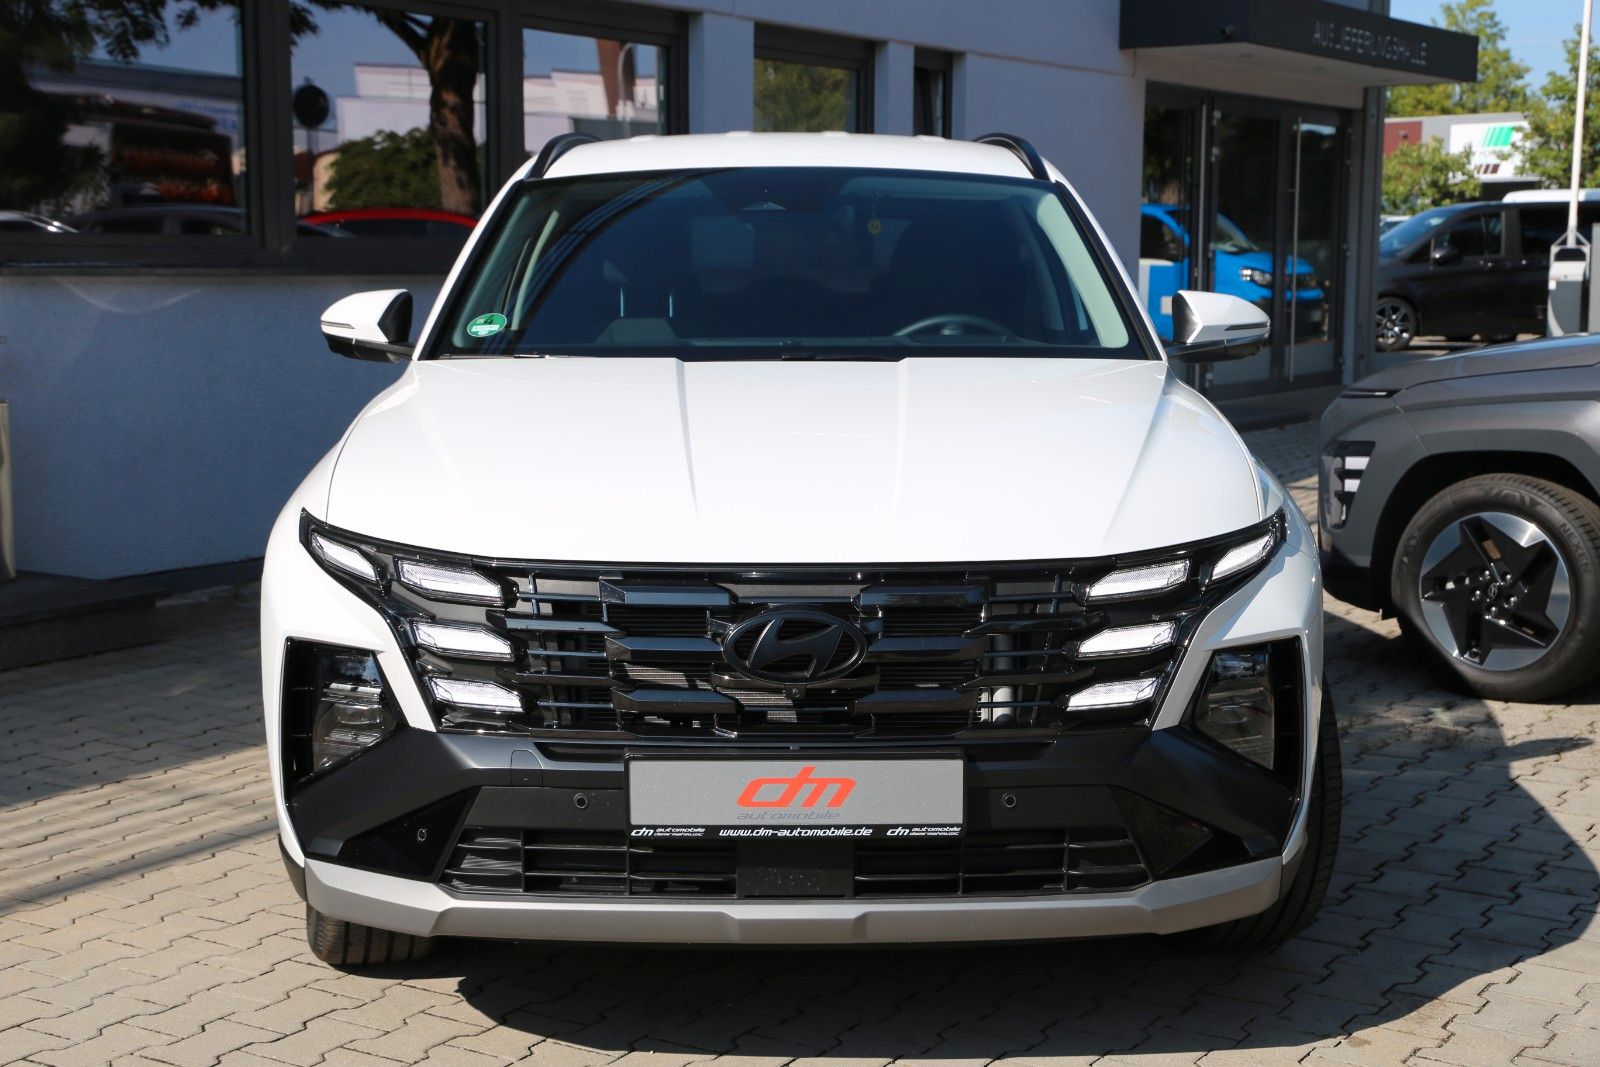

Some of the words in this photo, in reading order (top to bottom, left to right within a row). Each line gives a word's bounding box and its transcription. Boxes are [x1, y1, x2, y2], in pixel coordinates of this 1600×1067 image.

[1559, 522, 1592, 572] NEXEN
[736, 765, 856, 808] dm
[736, 811, 840, 821] automobile
[630, 827, 654, 837] dm
[719, 827, 873, 837] www.dm-automobile.de
[886, 826, 910, 836] dm
